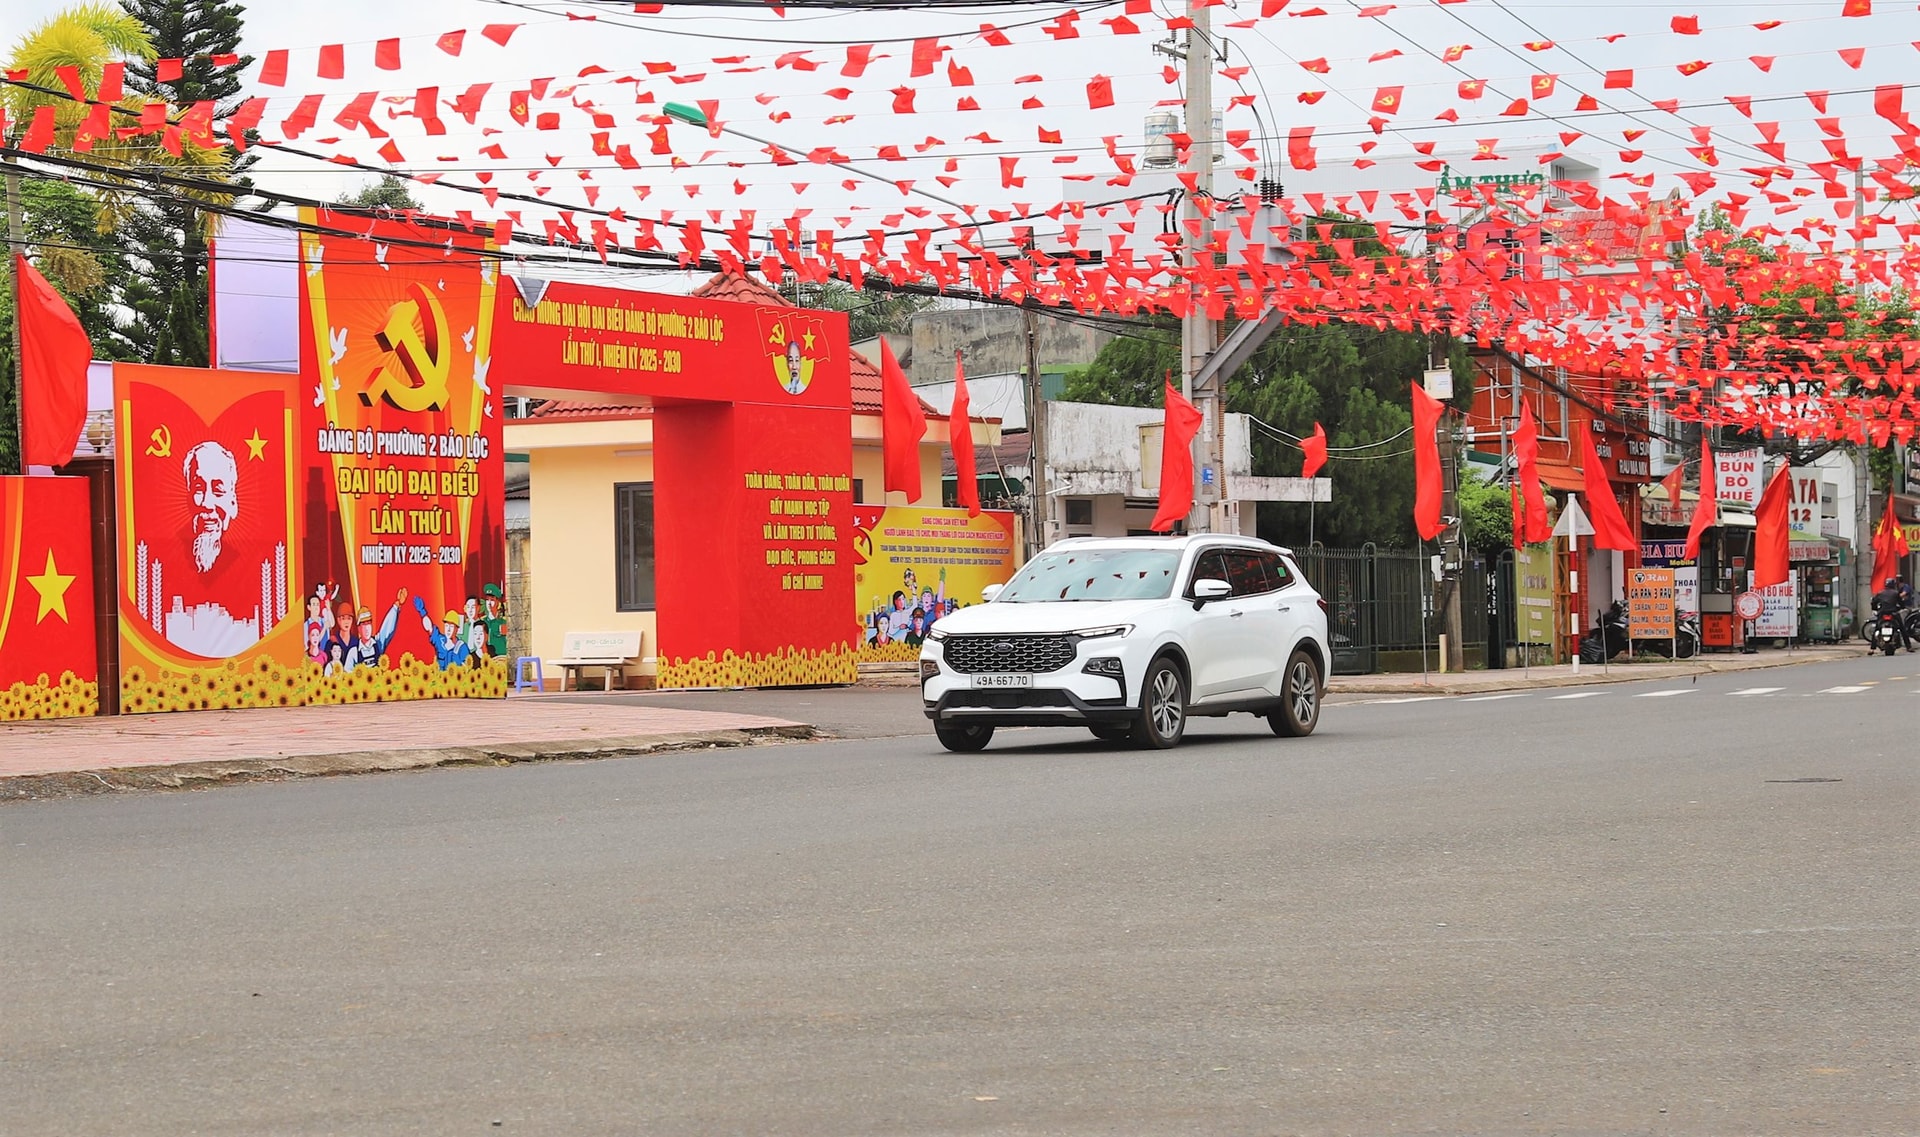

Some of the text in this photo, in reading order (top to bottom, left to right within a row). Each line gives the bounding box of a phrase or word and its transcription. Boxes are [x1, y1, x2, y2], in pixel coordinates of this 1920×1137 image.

[562, 303, 576, 332] ĐẠI
[577, 301, 590, 333] HỘI
[592, 306, 605, 334] ĐẠI
[606, 299, 623, 332] BIỂU
[625, 302, 644, 334] ĐẢNG
[646, 308, 657, 340] BỘ
[657, 308, 687, 338] PHƯỜNG
[688, 321, 693, 339] 2
[694, 310, 710, 341] BẢO
[711, 314, 724, 346] LỘC
[563, 333, 578, 364] LẦN
[580, 338, 595, 366] THỨ
[603, 340, 627, 373] NHIỆM
[628, 342, 638, 370] KỲ
[640, 348, 657, 372] 2025
[664, 350, 681, 373] 2030
[318, 422, 488, 463] ĐẢNG BỘ PHƯỜNG 2 BẢO LỘC
[1720, 459, 1754, 472] BÚN
[338, 462, 479, 500] ĐẠI HỘI ĐẠI BIỂU
[1720, 488, 1754, 501] HUẾ
[1725, 474, 1748, 487] BÒ
[370, 502, 452, 535] LẦN THỨ I
[362, 542, 392, 567] NHIỆM
[395, 543, 406, 564] KỲ
[409, 546, 431, 564] 2025
[439, 546, 461, 564] 2030
[977, 676, 1027, 686] 49A-667.70
